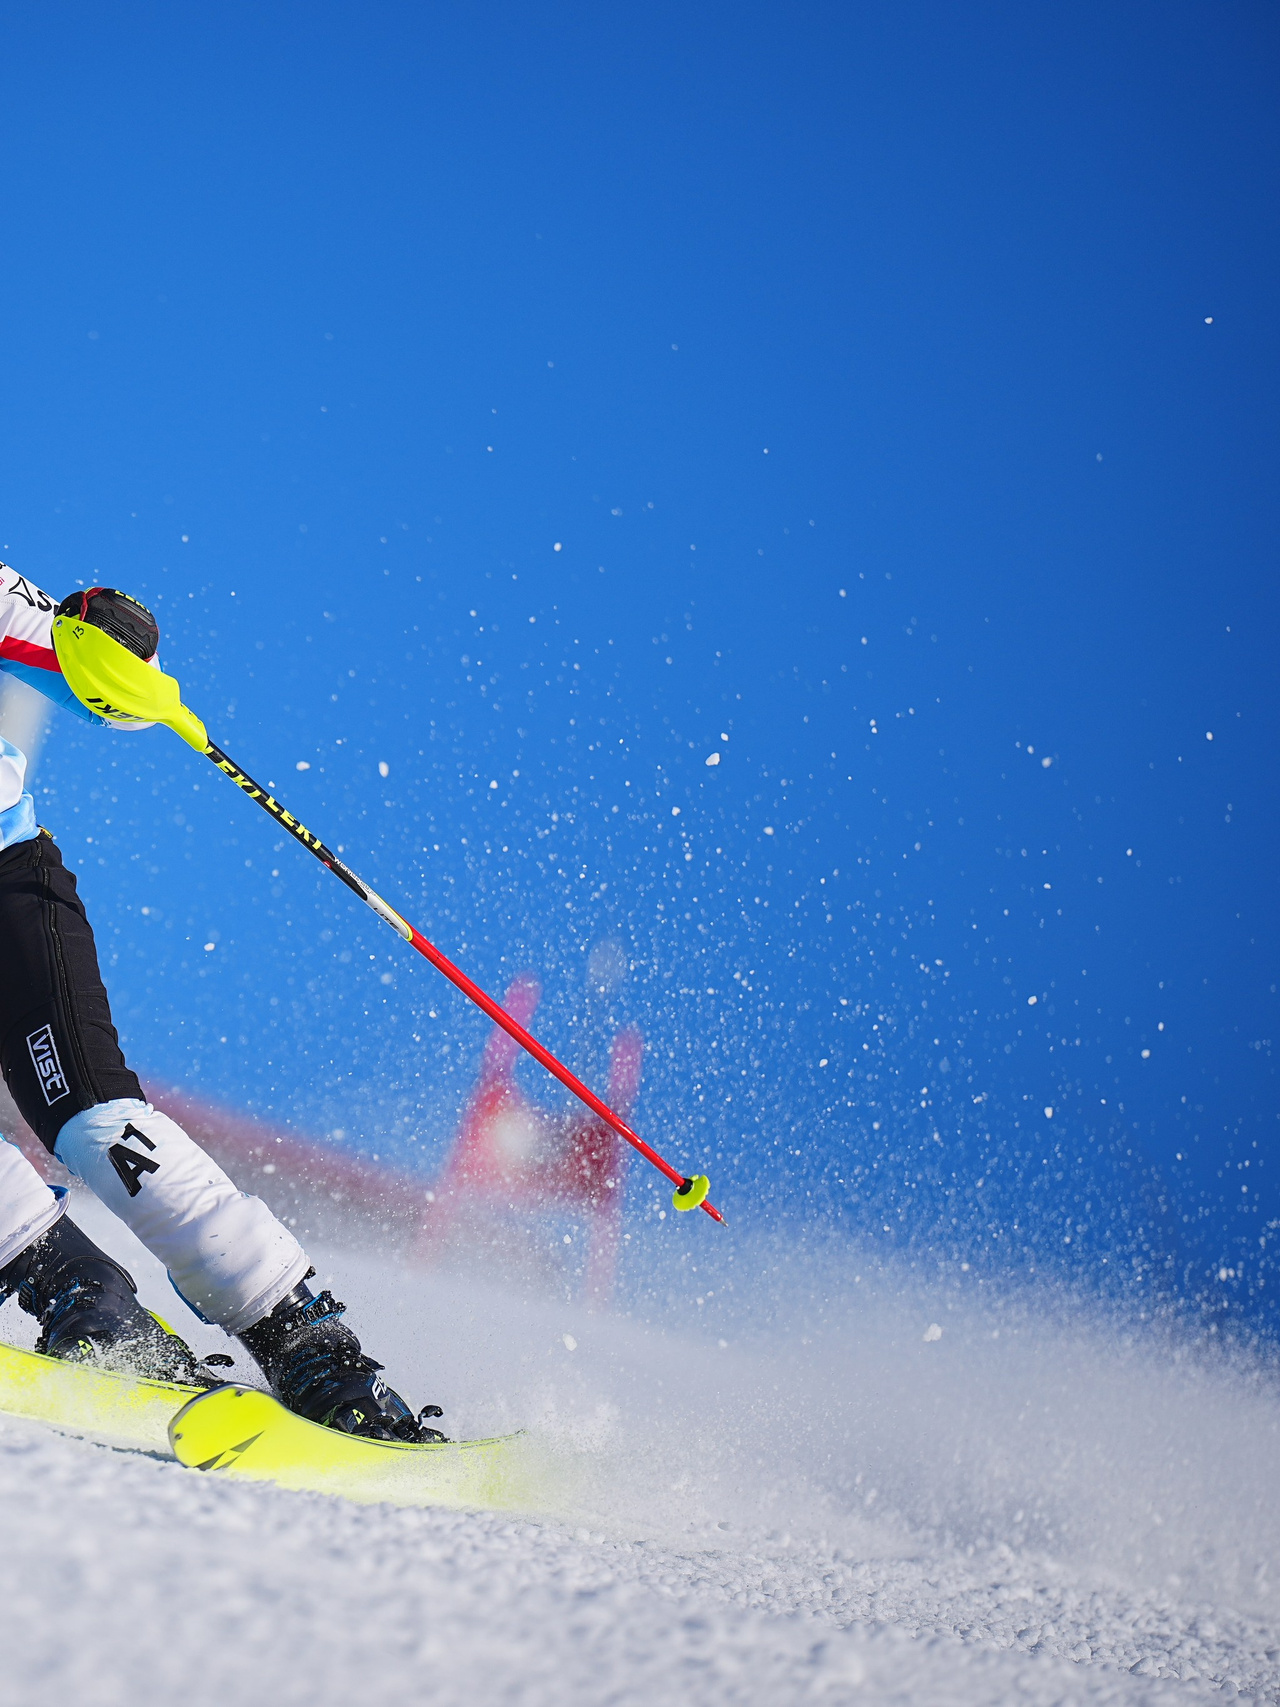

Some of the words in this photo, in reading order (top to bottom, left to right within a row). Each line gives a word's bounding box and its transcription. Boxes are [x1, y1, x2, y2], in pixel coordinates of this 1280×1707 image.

[72, 625, 85, 640] 13
[265, 795, 322, 850] LEKI
[108, 1122, 161, 1198] A1
